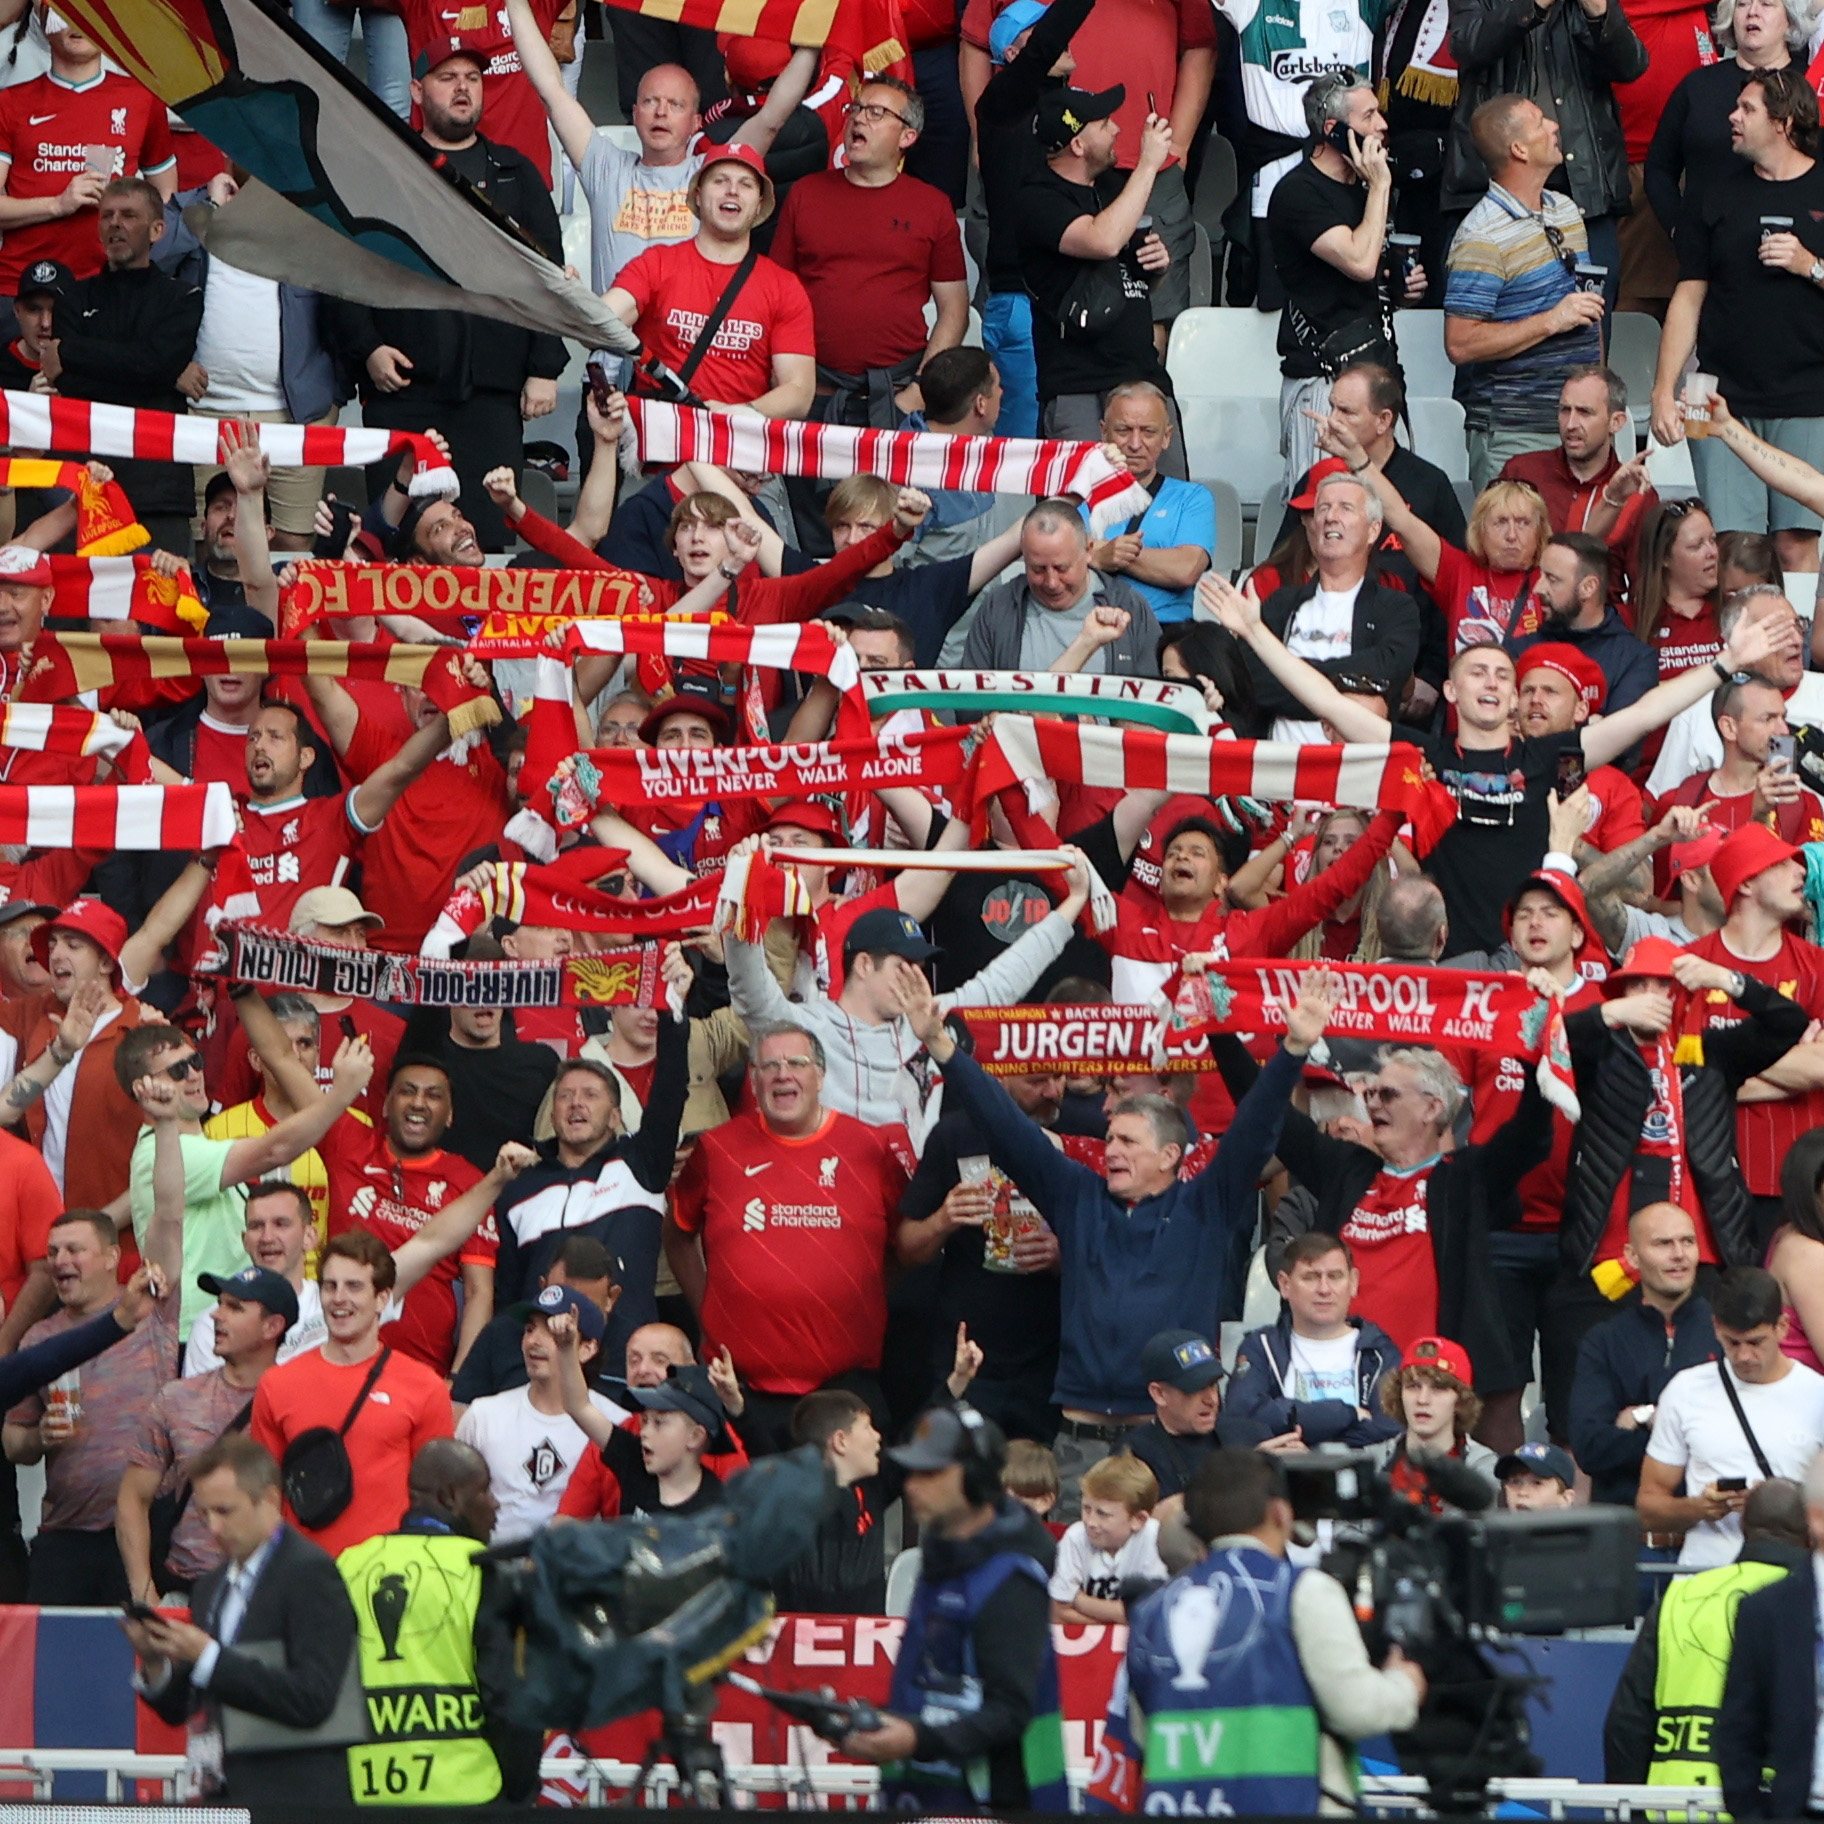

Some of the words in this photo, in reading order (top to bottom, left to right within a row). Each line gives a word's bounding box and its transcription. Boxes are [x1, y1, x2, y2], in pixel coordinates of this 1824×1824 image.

[1265, 14, 1294, 27] adidas
[1273, 53, 1352, 77] Carlsberg
[298, 567, 350, 615] FC
[357, 567, 639, 616] LIVERPOOL
[479, 639, 531, 648] AUSTRALIA
[1660, 643, 1721, 657] Standard
[869, 673, 1182, 704] PALESTINE
[641, 779, 708, 798] YOU'LL
[717, 773, 777, 792] NEVER
[797, 764, 847, 784] WALK
[861, 757, 923, 779] ALONE
[237, 932, 319, 990] MILAN
[333, 959, 375, 1001] AC
[416, 965, 560, 1007] LIVERPOOL
[1065, 1008, 1098, 1019] BACK
[1102, 1007, 1121, 1018] ON
[1460, 981, 1505, 1022] FC
[994, 1022, 1133, 1059] JURGEN
[1387, 1015, 1432, 1034] WALK
[1441, 1018, 1495, 1041] ALONE
[770, 1203, 838, 1216] standard
[770, 1216, 842, 1229] chartered
[1155, 1719, 1223, 1769] TV
[362, 1755, 434, 1796] 167
